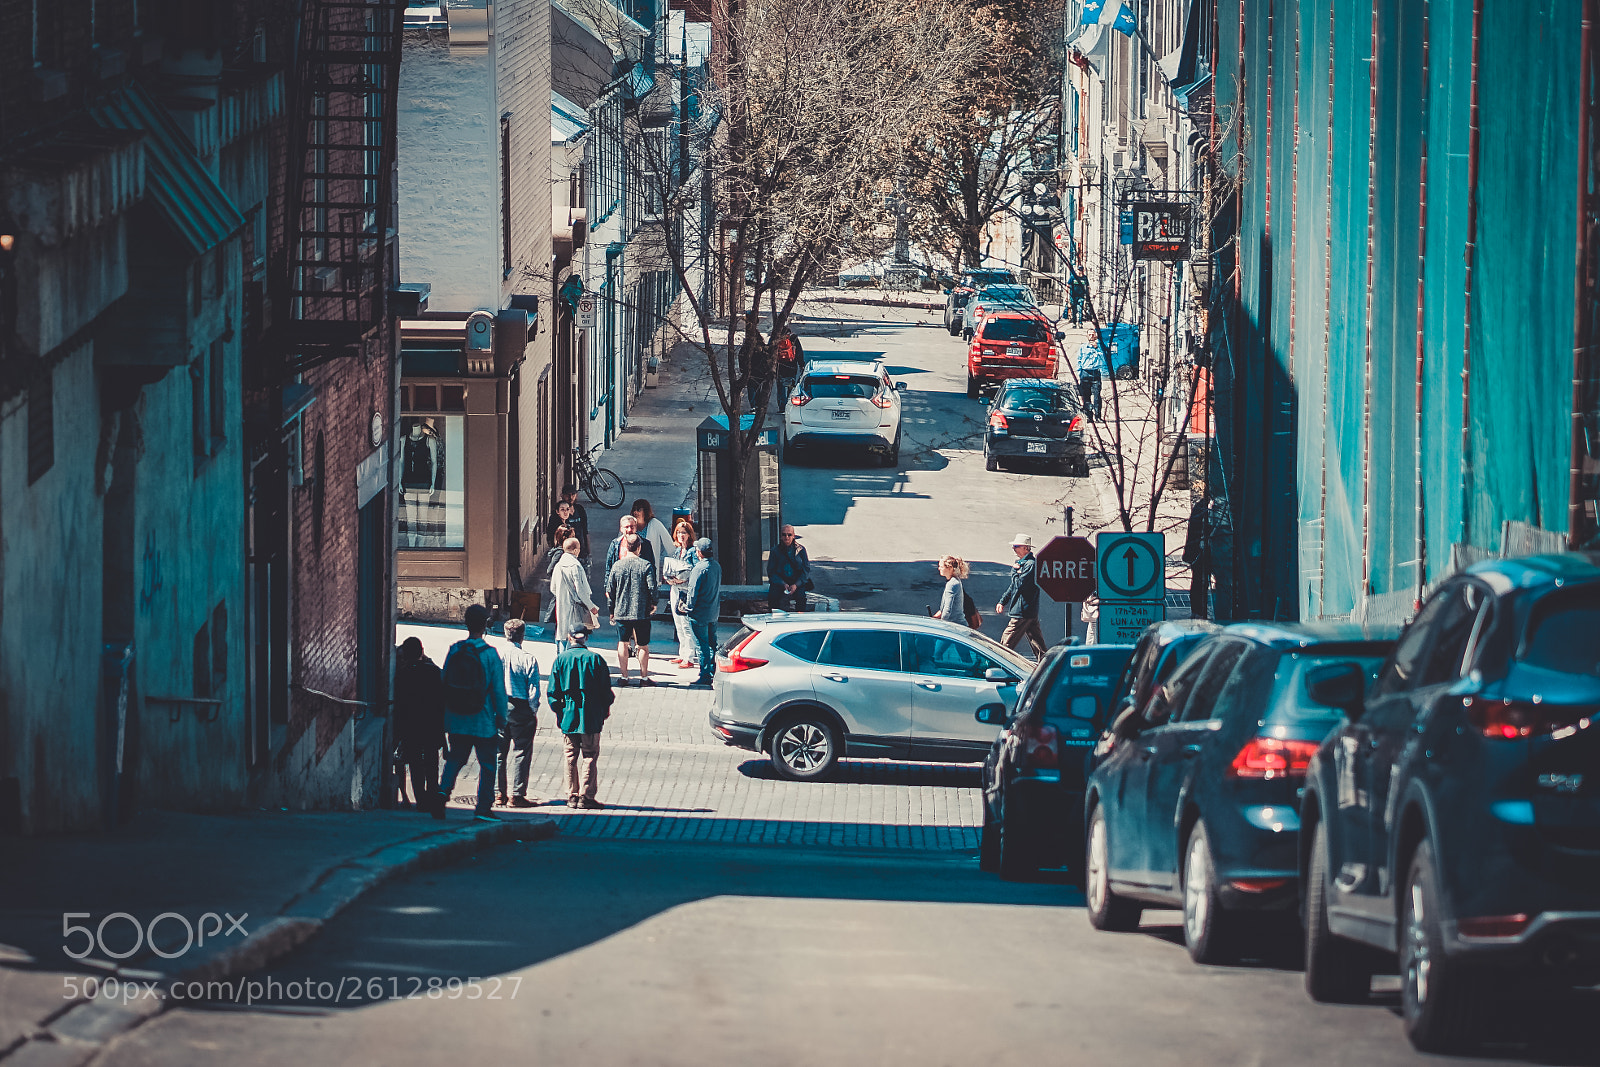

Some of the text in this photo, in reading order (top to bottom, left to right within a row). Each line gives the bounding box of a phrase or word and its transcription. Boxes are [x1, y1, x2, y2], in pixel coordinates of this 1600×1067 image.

[707, 432, 720, 447] Bell
[1039, 557, 1098, 579] ARRÊT
[1114, 607, 1148, 615] 17h-24h
[1110, 617, 1127, 626] LUN
[1135, 617, 1152, 626] VEN
[1116, 630, 1141, 639] 9h-24
